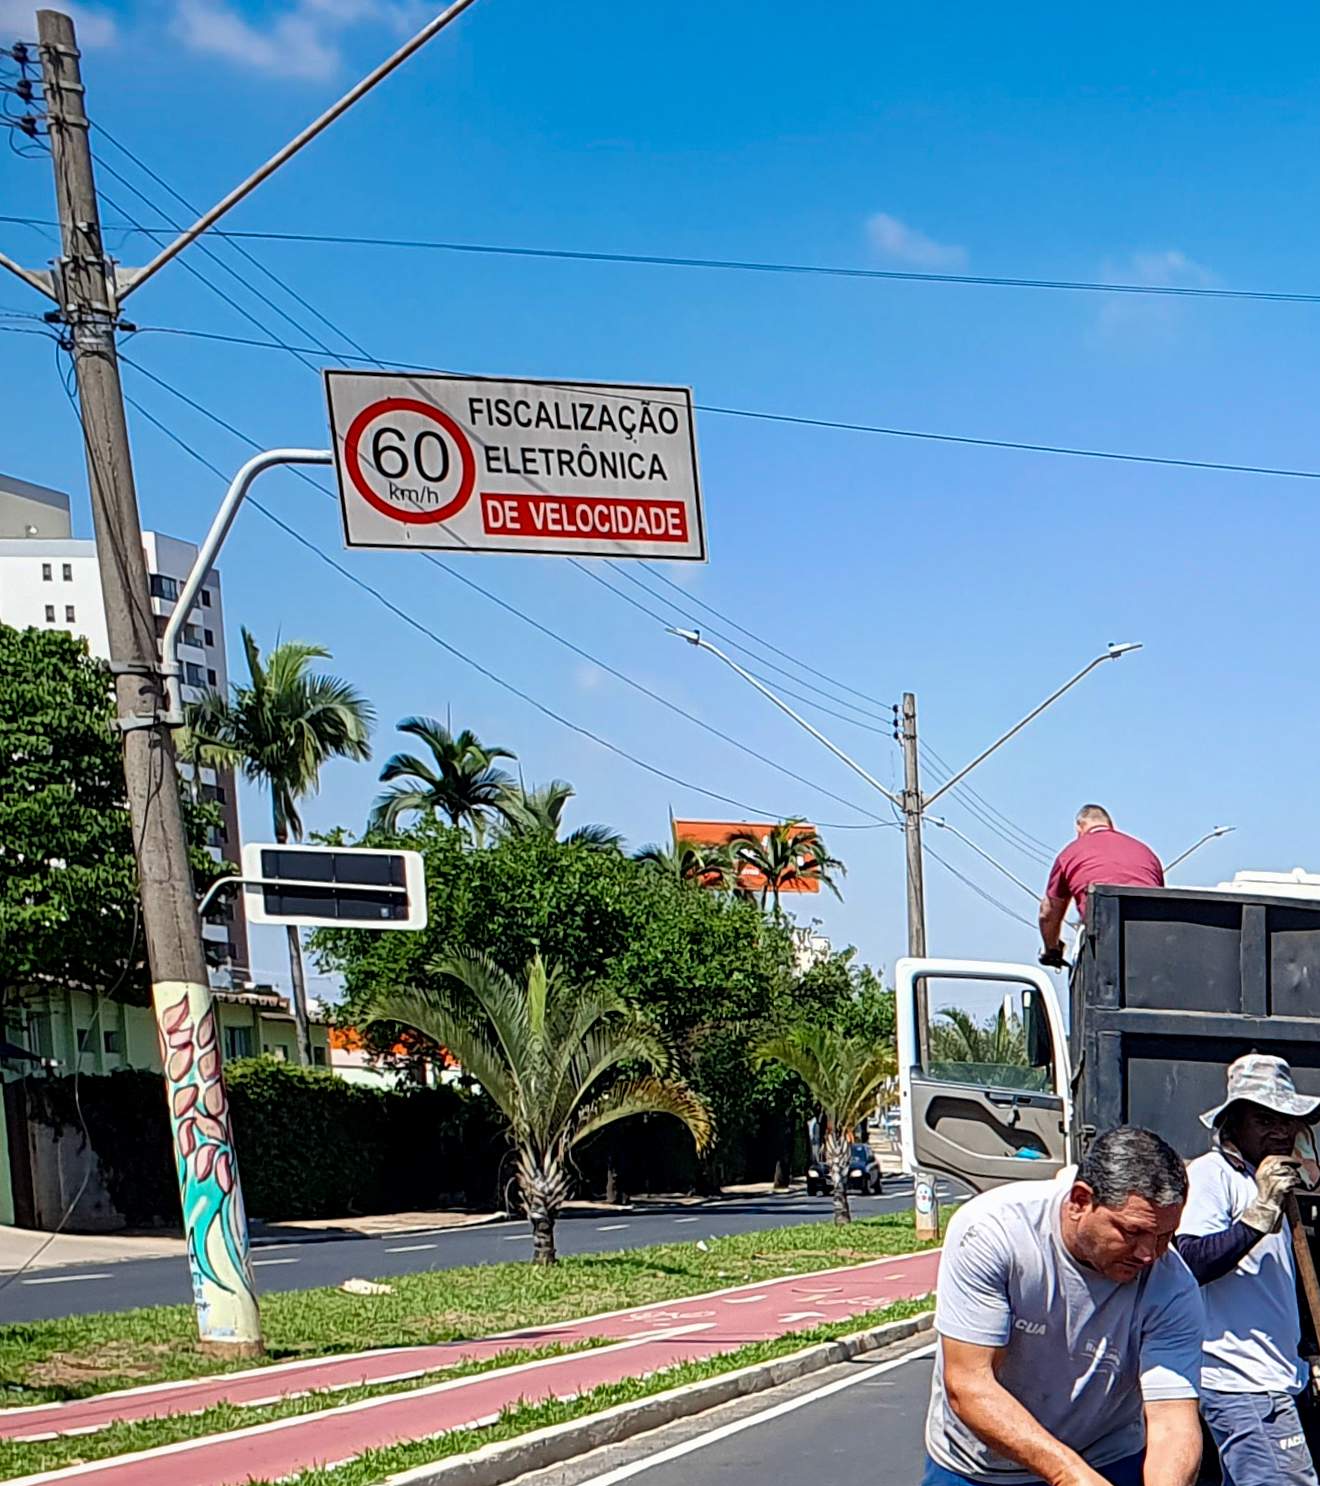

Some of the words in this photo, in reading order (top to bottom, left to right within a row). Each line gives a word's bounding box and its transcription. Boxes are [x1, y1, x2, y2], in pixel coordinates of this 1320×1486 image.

[468, 397, 679, 441] FISCALIZAÇÃO
[372, 427, 450, 483] 60
[484, 443, 668, 481] ELETRÔNICA
[389, 482, 439, 504] km/h
[486, 499, 521, 530] DE
[528, 501, 684, 536] VELOCIDADE
